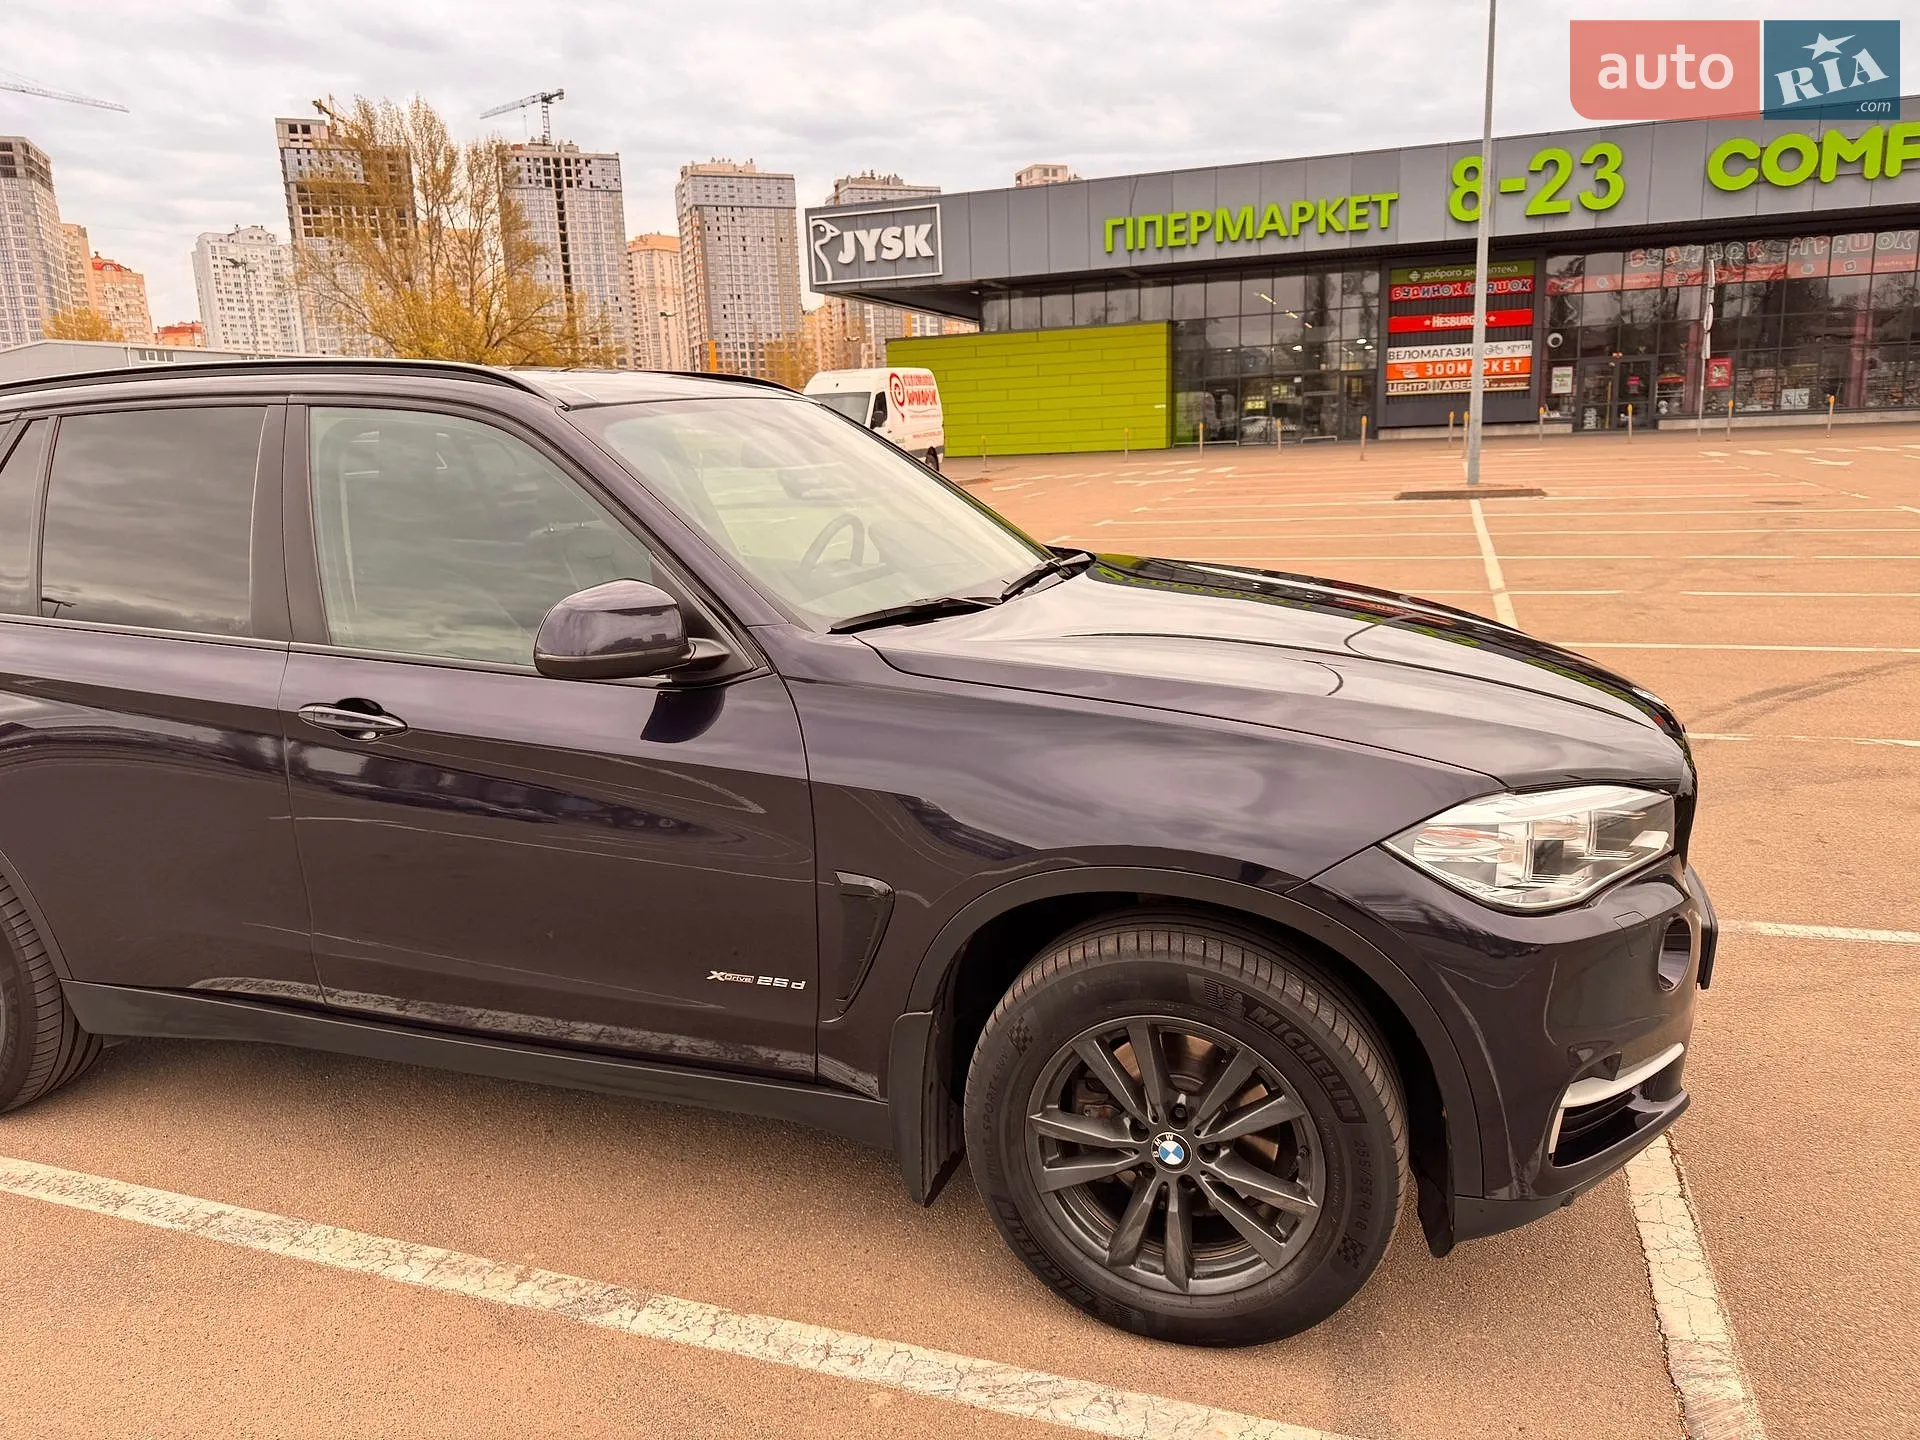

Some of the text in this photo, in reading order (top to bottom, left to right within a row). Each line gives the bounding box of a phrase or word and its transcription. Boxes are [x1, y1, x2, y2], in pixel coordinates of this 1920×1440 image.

[1449, 142, 1625, 222] 8-23
[1104, 192, 1399, 253] ГІПЕРМАРКЕТ
[837, 223, 934, 265] JYSK
[1423, 265, 1518, 280] доброго дн птека
[1391, 283, 1463, 300] БУДИНОК
[1388, 347, 1473, 360] ВЕЛОМАГАЗИ
[1425, 360, 1522, 376] ЗООМРКЕТ
[1388, 382, 1427, 392] ЦЕНТР
[1442, 378, 1491, 390] ДВЕРЙ
[1248, 1005, 1362, 1119] MICHELIN
[982, 1082, 998, 1132] SPORT
[1152, 1133, 1175, 1159] BMW
[1358, 1200, 1373, 1211] R
[1354, 1215, 1369, 1231] 18
